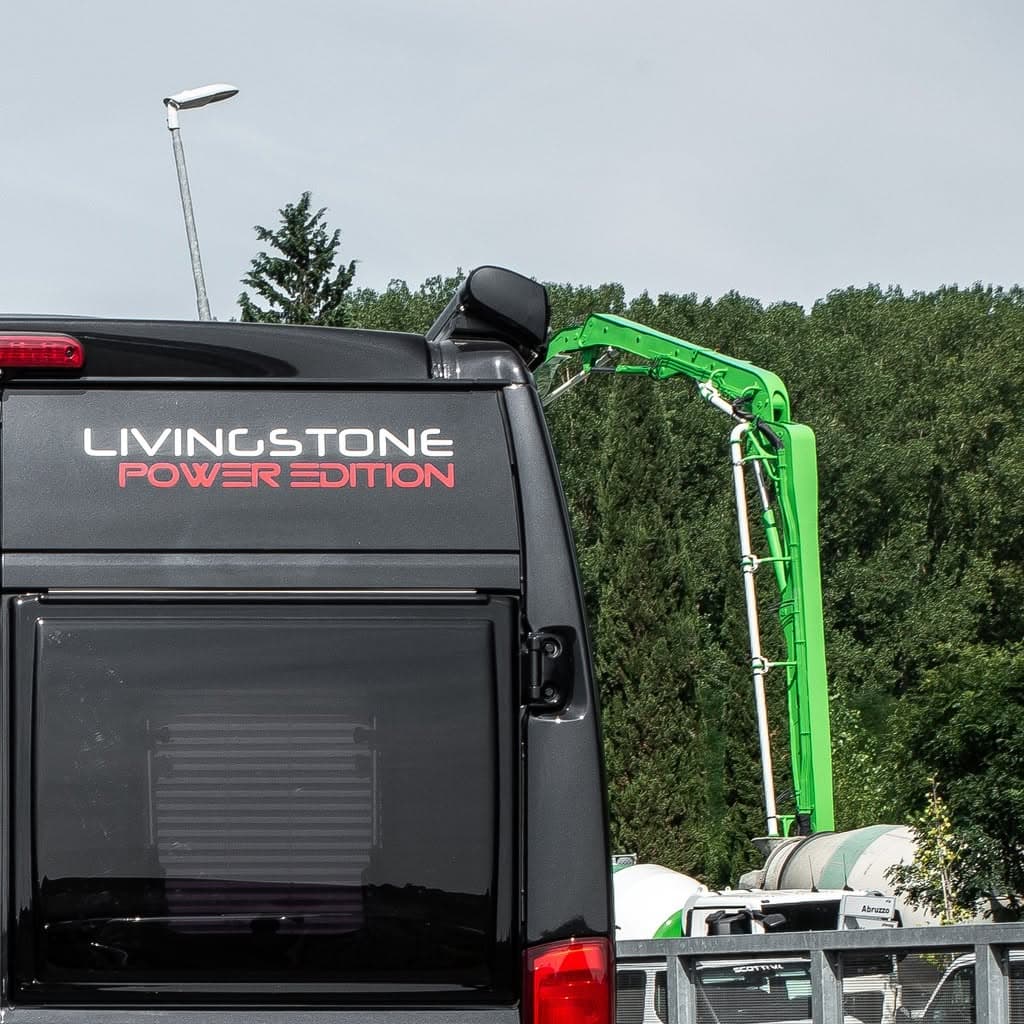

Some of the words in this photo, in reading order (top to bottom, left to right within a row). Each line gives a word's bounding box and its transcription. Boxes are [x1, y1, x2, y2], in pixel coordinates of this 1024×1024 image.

[83, 428, 455, 457] LIVINGSTONE
[118, 462, 281, 488] POWER
[289, 462, 456, 488] EDITION
[861, 905, 890, 914] Abruzzo
